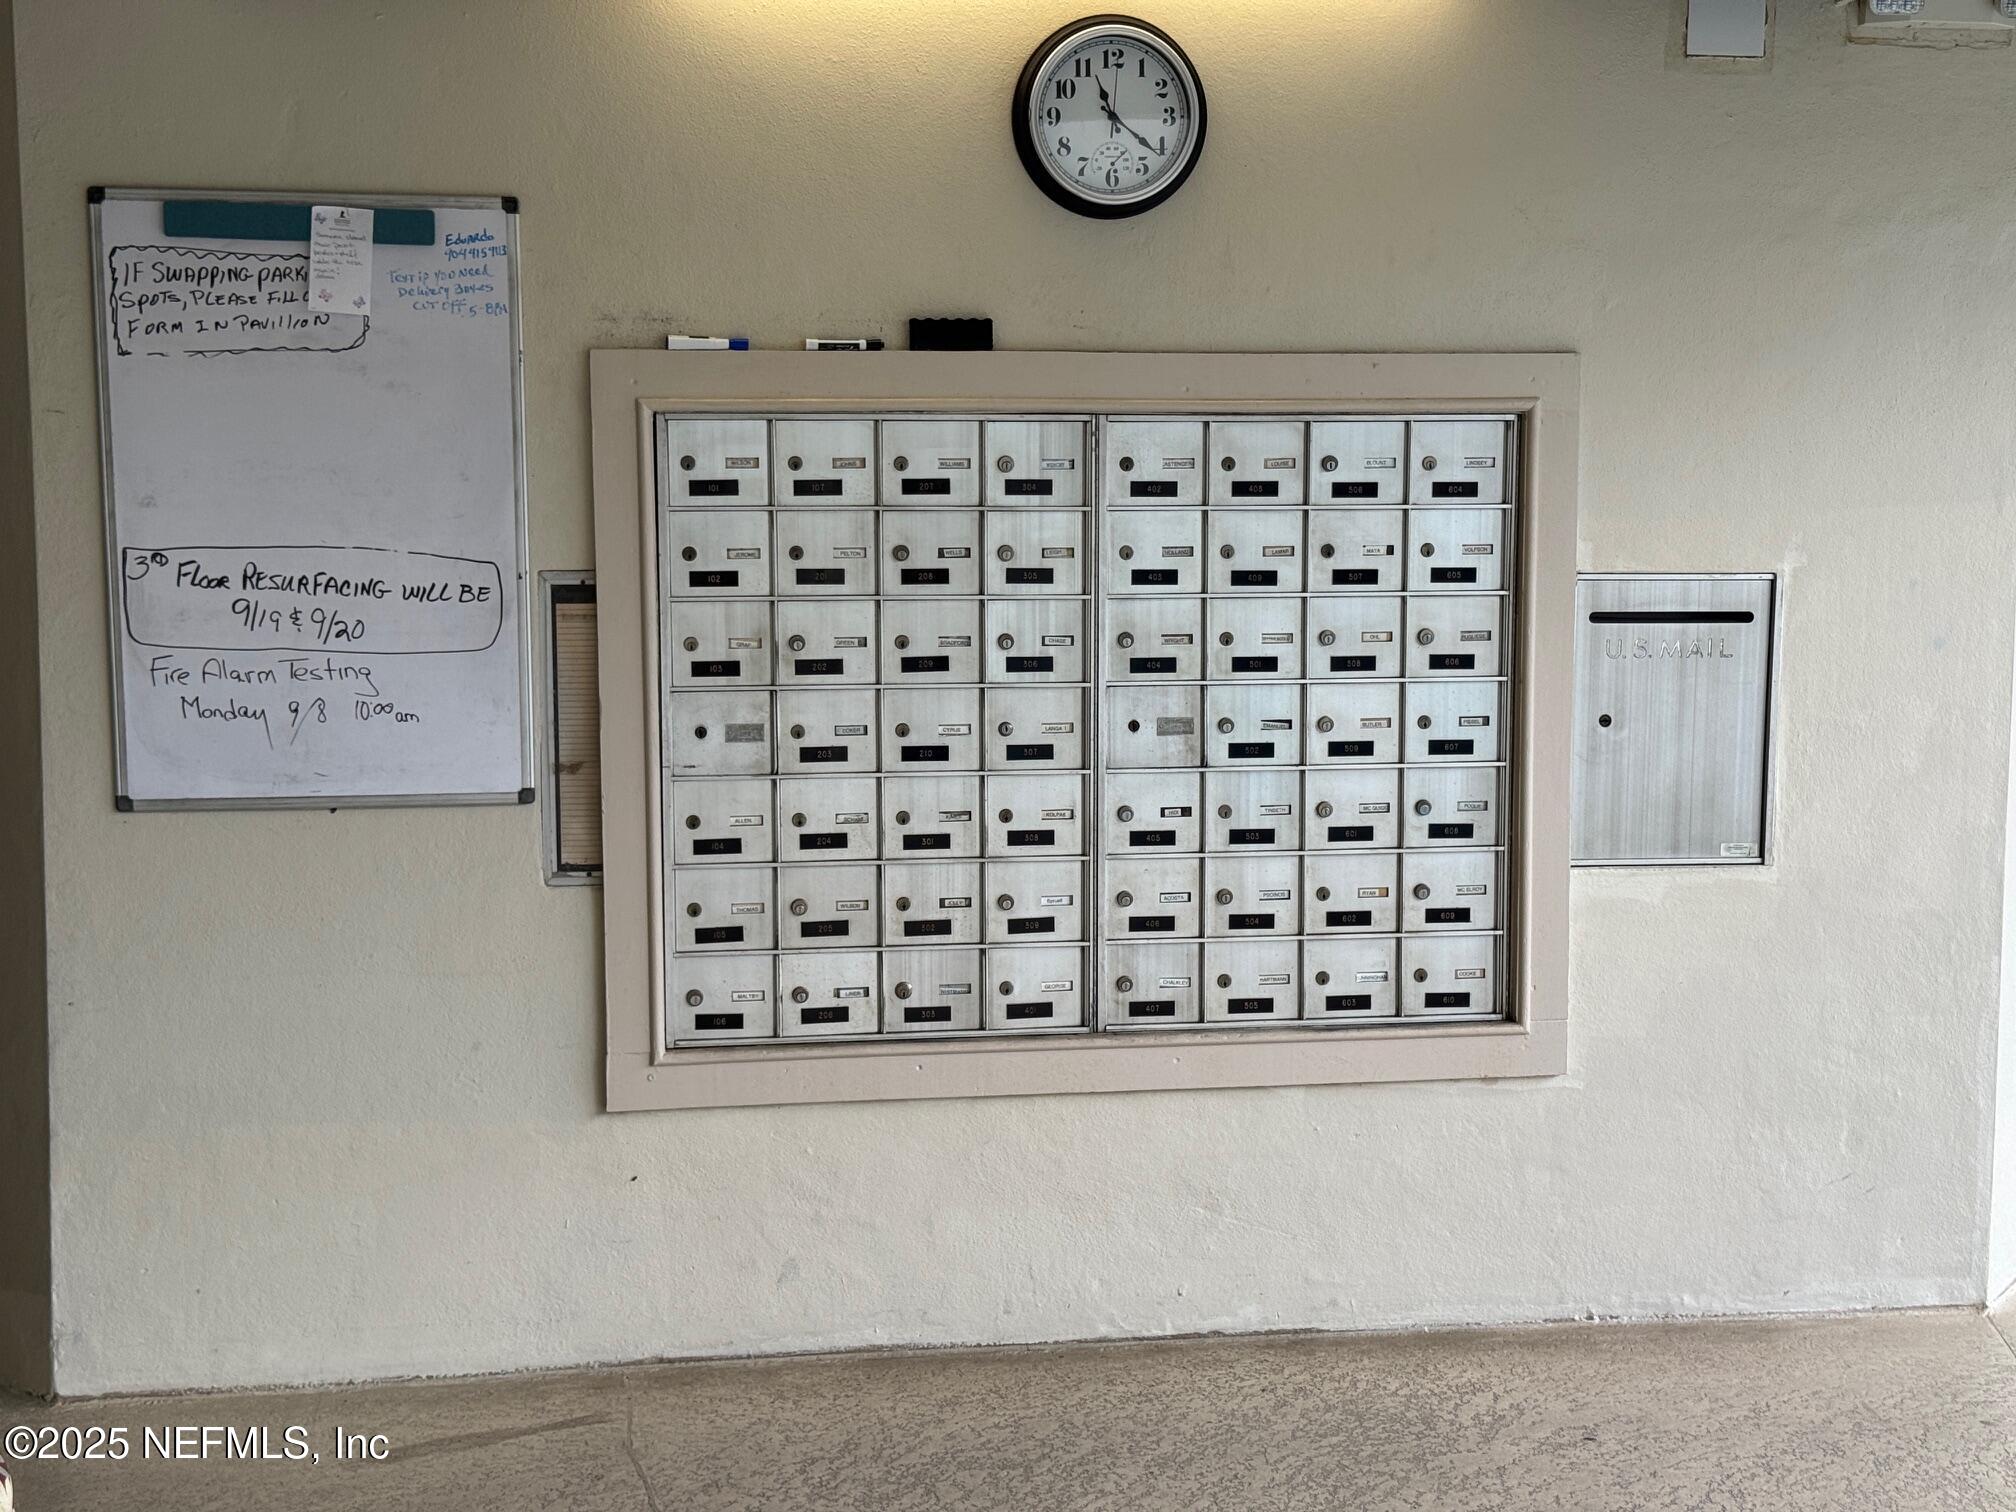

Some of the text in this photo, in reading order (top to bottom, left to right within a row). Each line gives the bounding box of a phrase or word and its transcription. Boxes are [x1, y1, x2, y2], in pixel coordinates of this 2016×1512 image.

[1074, 58, 1092, 78] 11
[1102, 48, 1124, 70] 12
[1138, 58, 1145, 78] 1
[1055, 78, 1076, 100] 10
[1155, 78, 1168, 98] 2
[1046, 106, 1061, 127] 9
[1162, 106, 1176, 126] 3
[1056, 136, 1071, 156] 8
[1151, 136, 1168, 156] 4
[1077, 156, 1090, 176] 7
[1135, 156, 1150, 176] 5
[1105, 167, 1120, 188] 6
[124, 261, 309, 292] IF SWAPPING PARKI
[118, 290, 188, 314] SPOTS,
[189, 290, 258, 306] PLEASE
[128, 318, 184, 338] FORM
[195, 320, 228, 333] IN
[241, 560, 392, 600] RESURFACING
[402, 583, 453, 603] WILL
[458, 584, 492, 604] BE
[231, 596, 281, 633] 9/19
[311, 608, 366, 645] 9/20
[1659, 638, 1734, 660] MAIL
[150, 656, 380, 698] Fire Alarm Testing
[180, 696, 274, 750] Monday
[288, 697, 328, 747] 9/8
